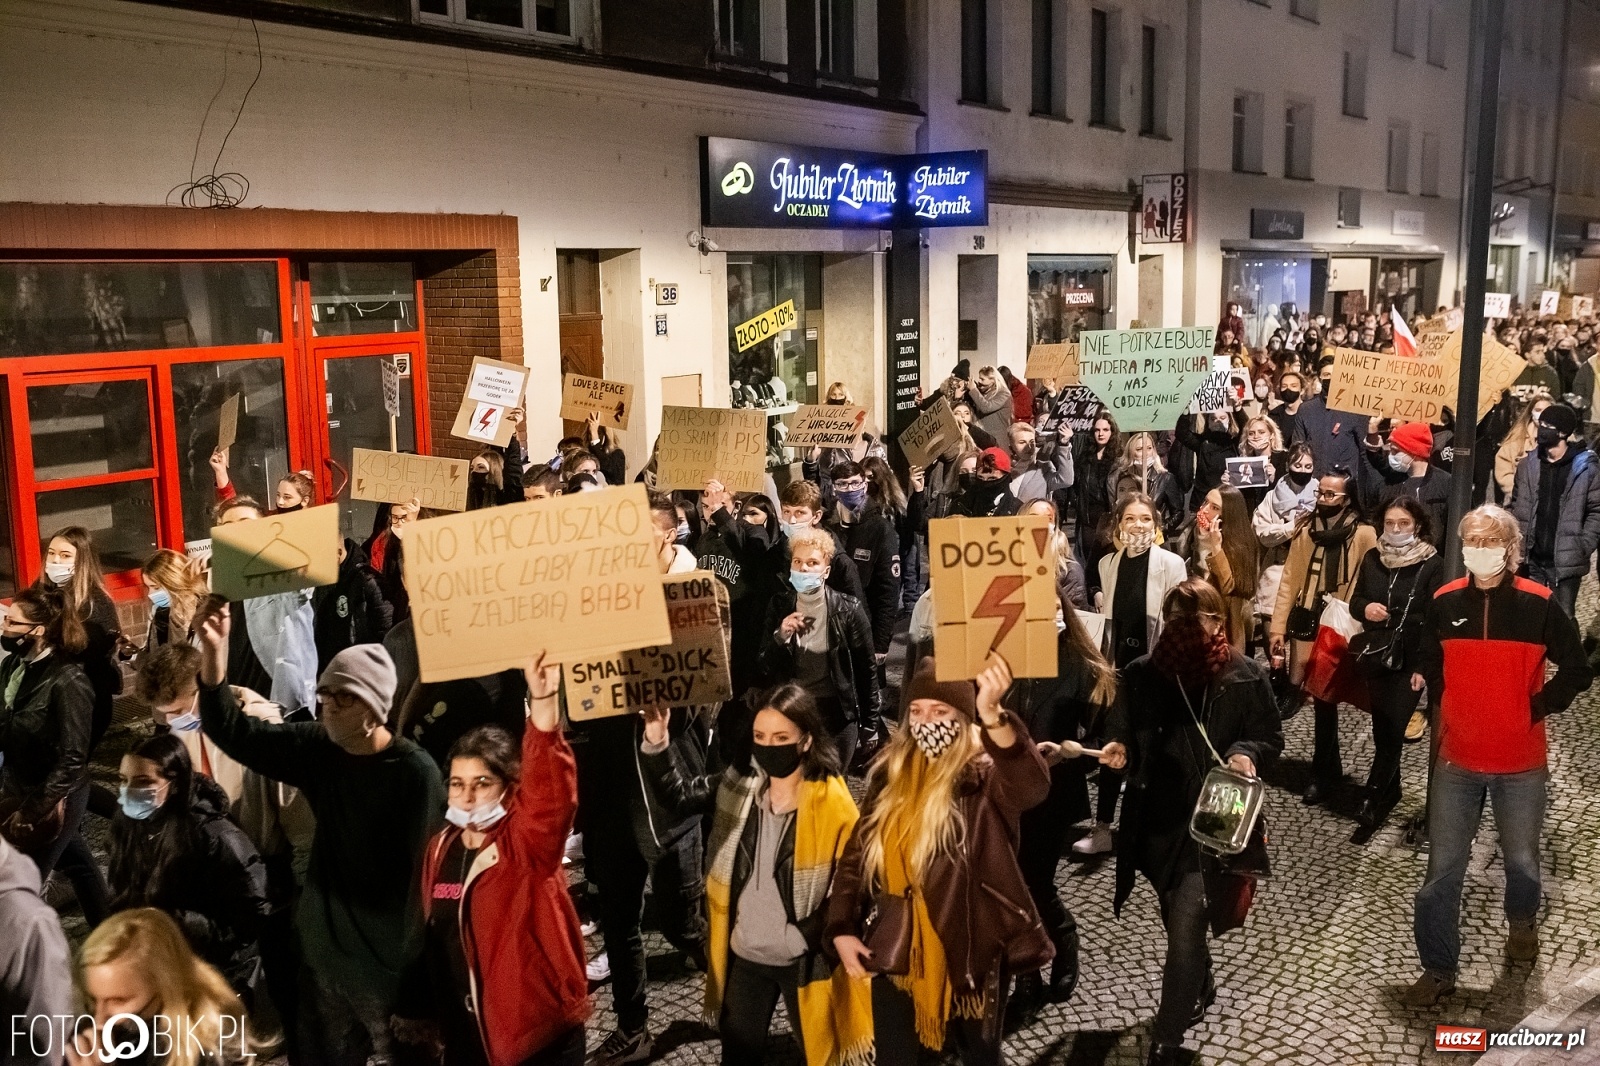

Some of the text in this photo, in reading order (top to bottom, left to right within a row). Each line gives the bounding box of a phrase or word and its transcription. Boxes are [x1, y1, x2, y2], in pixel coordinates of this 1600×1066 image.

[770, 157, 897, 213] Jubiler Złotnik
[914, 165, 971, 194] Jubiler
[786, 203, 830, 217] OCZADŁY
[914, 194, 972, 219] Złotnik
[662, 287, 677, 301] 36
[1065, 291, 1094, 304] PRZECENA
[737, 304, 794, 348] ZŁOTO -10%
[1084, 329, 1212, 356] NIE POTRZEBUJE
[1080, 359, 1138, 376] TINDERA
[1143, 358, 1162, 373] PIS
[1167, 355, 1209, 374] RUCHA
[1340, 353, 1444, 379] NAWET MEFEDRON
[485, 377, 511, 385] HALLOWEEN
[572, 377, 625, 395] LOVE & PEACE
[1123, 376, 1148, 391] NAS
[1339, 371, 1446, 397] MA LEPSZY SKŁAD
[588, 390, 603, 400] ALE
[1112, 393, 1181, 409] CODZIENNIE
[1198, 398, 1224, 412] PRAW
[663, 409, 763, 429] MARS OD TYŁU
[796, 419, 807, 429] Z
[806, 406, 852, 419] WALCZCIE
[901, 400, 943, 446] WELCOME
[660, 429, 680, 444] TO
[721, 431, 729, 446] A
[734, 432, 761, 455] PIS
[786, 432, 857, 445] NIE Z KOBIETAMI
[912, 419, 945, 449] TO HELL
[357, 453, 447, 488] KOBIETA
[660, 447, 751, 469] OD TYŁU JEST
[661, 469, 671, 484] W
[374, 482, 465, 510] DECYDUJE
[416, 499, 640, 566] NO KACZUSZKO
[417, 542, 653, 604] KONIEC LABY TERAZ
[683, 577, 715, 600] FOR
[419, 608, 453, 637] CIĘ
[468, 589, 569, 629] ZAJEBIĄ
[580, 584, 646, 617] BABY
[668, 603, 721, 630] IGHTS
[572, 647, 718, 684] SMALL DICK
[611, 673, 695, 709] ENERGY
